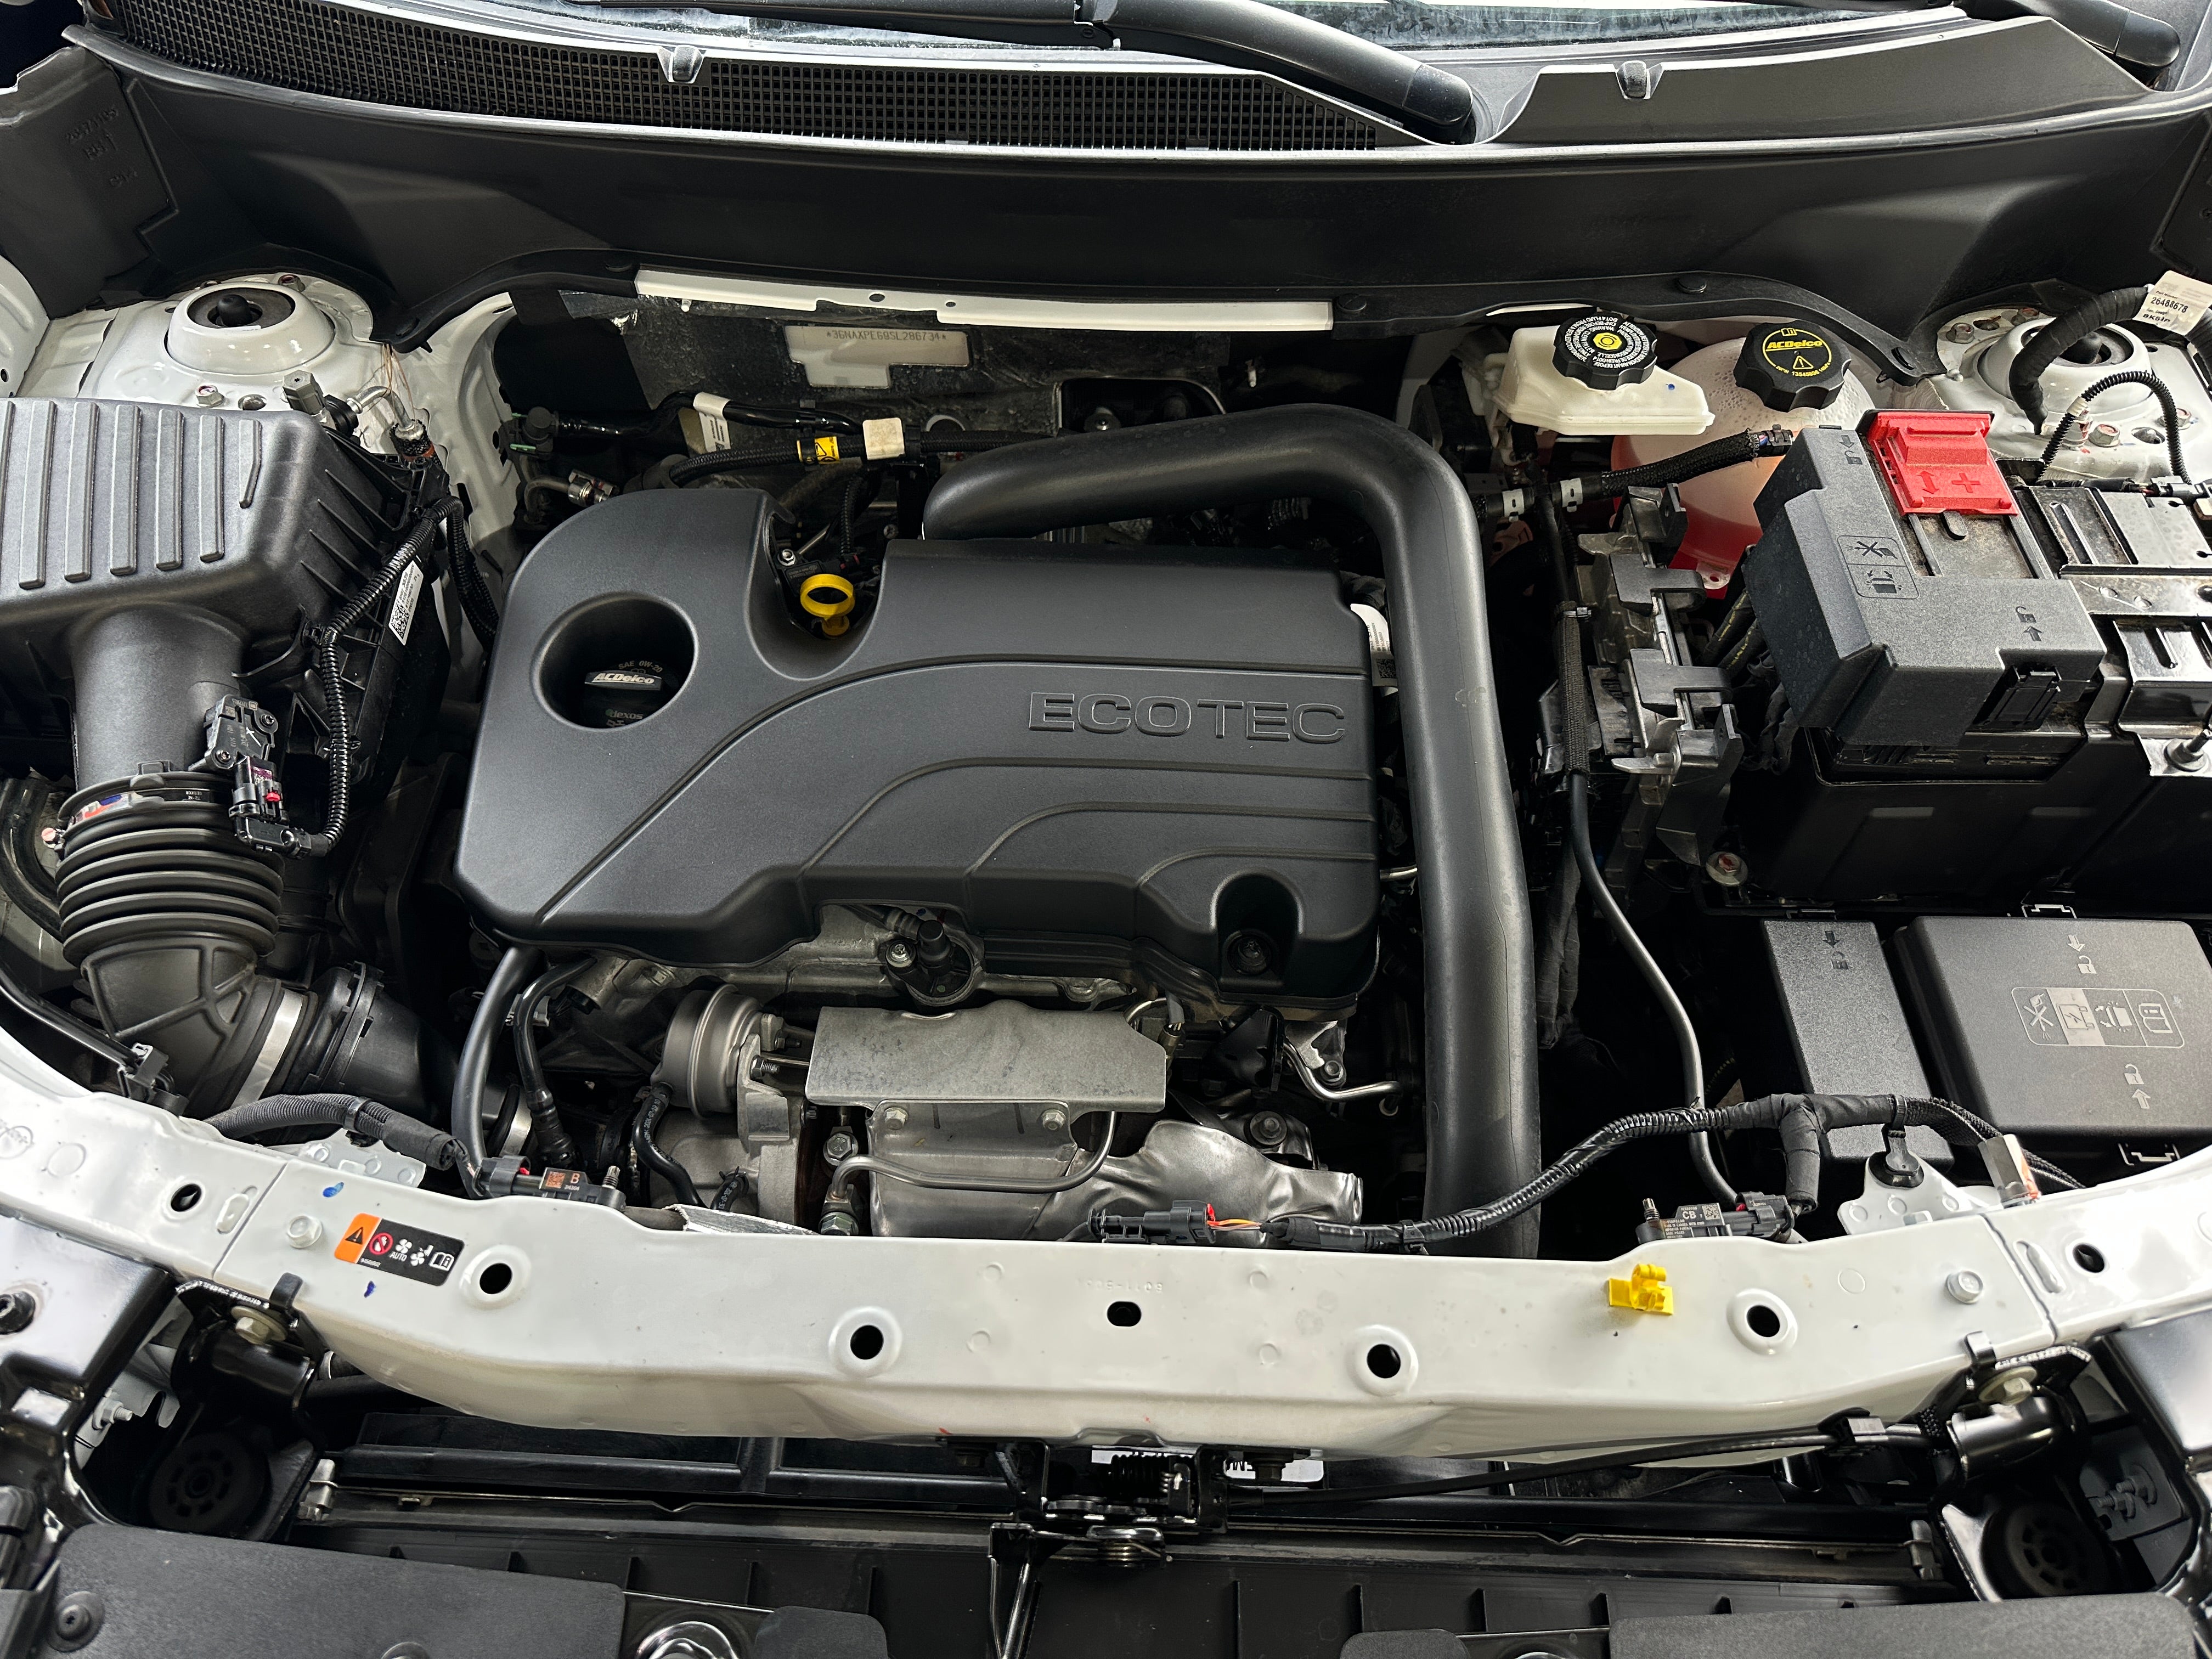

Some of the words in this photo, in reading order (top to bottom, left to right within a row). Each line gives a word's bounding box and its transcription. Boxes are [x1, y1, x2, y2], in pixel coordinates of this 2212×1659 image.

[2151, 297, 2188, 313] 26488678
[1571, 319, 1588, 328] FROM
[1564, 328, 1575, 342] SEALED
[1767, 340, 1823, 349] ACDelco
[1576, 347, 1592, 357] ONLY
[618, 660, 635, 669] SAE
[639, 660, 663, 673] 0W-20
[593, 673, 655, 685] ACDelco
[1029, 692, 1345, 743] ECOTEC
[570, 1172, 580, 1184] B
[1682, 1210, 1696, 1220] CB
[389, 1252, 408, 1262] AUTO
